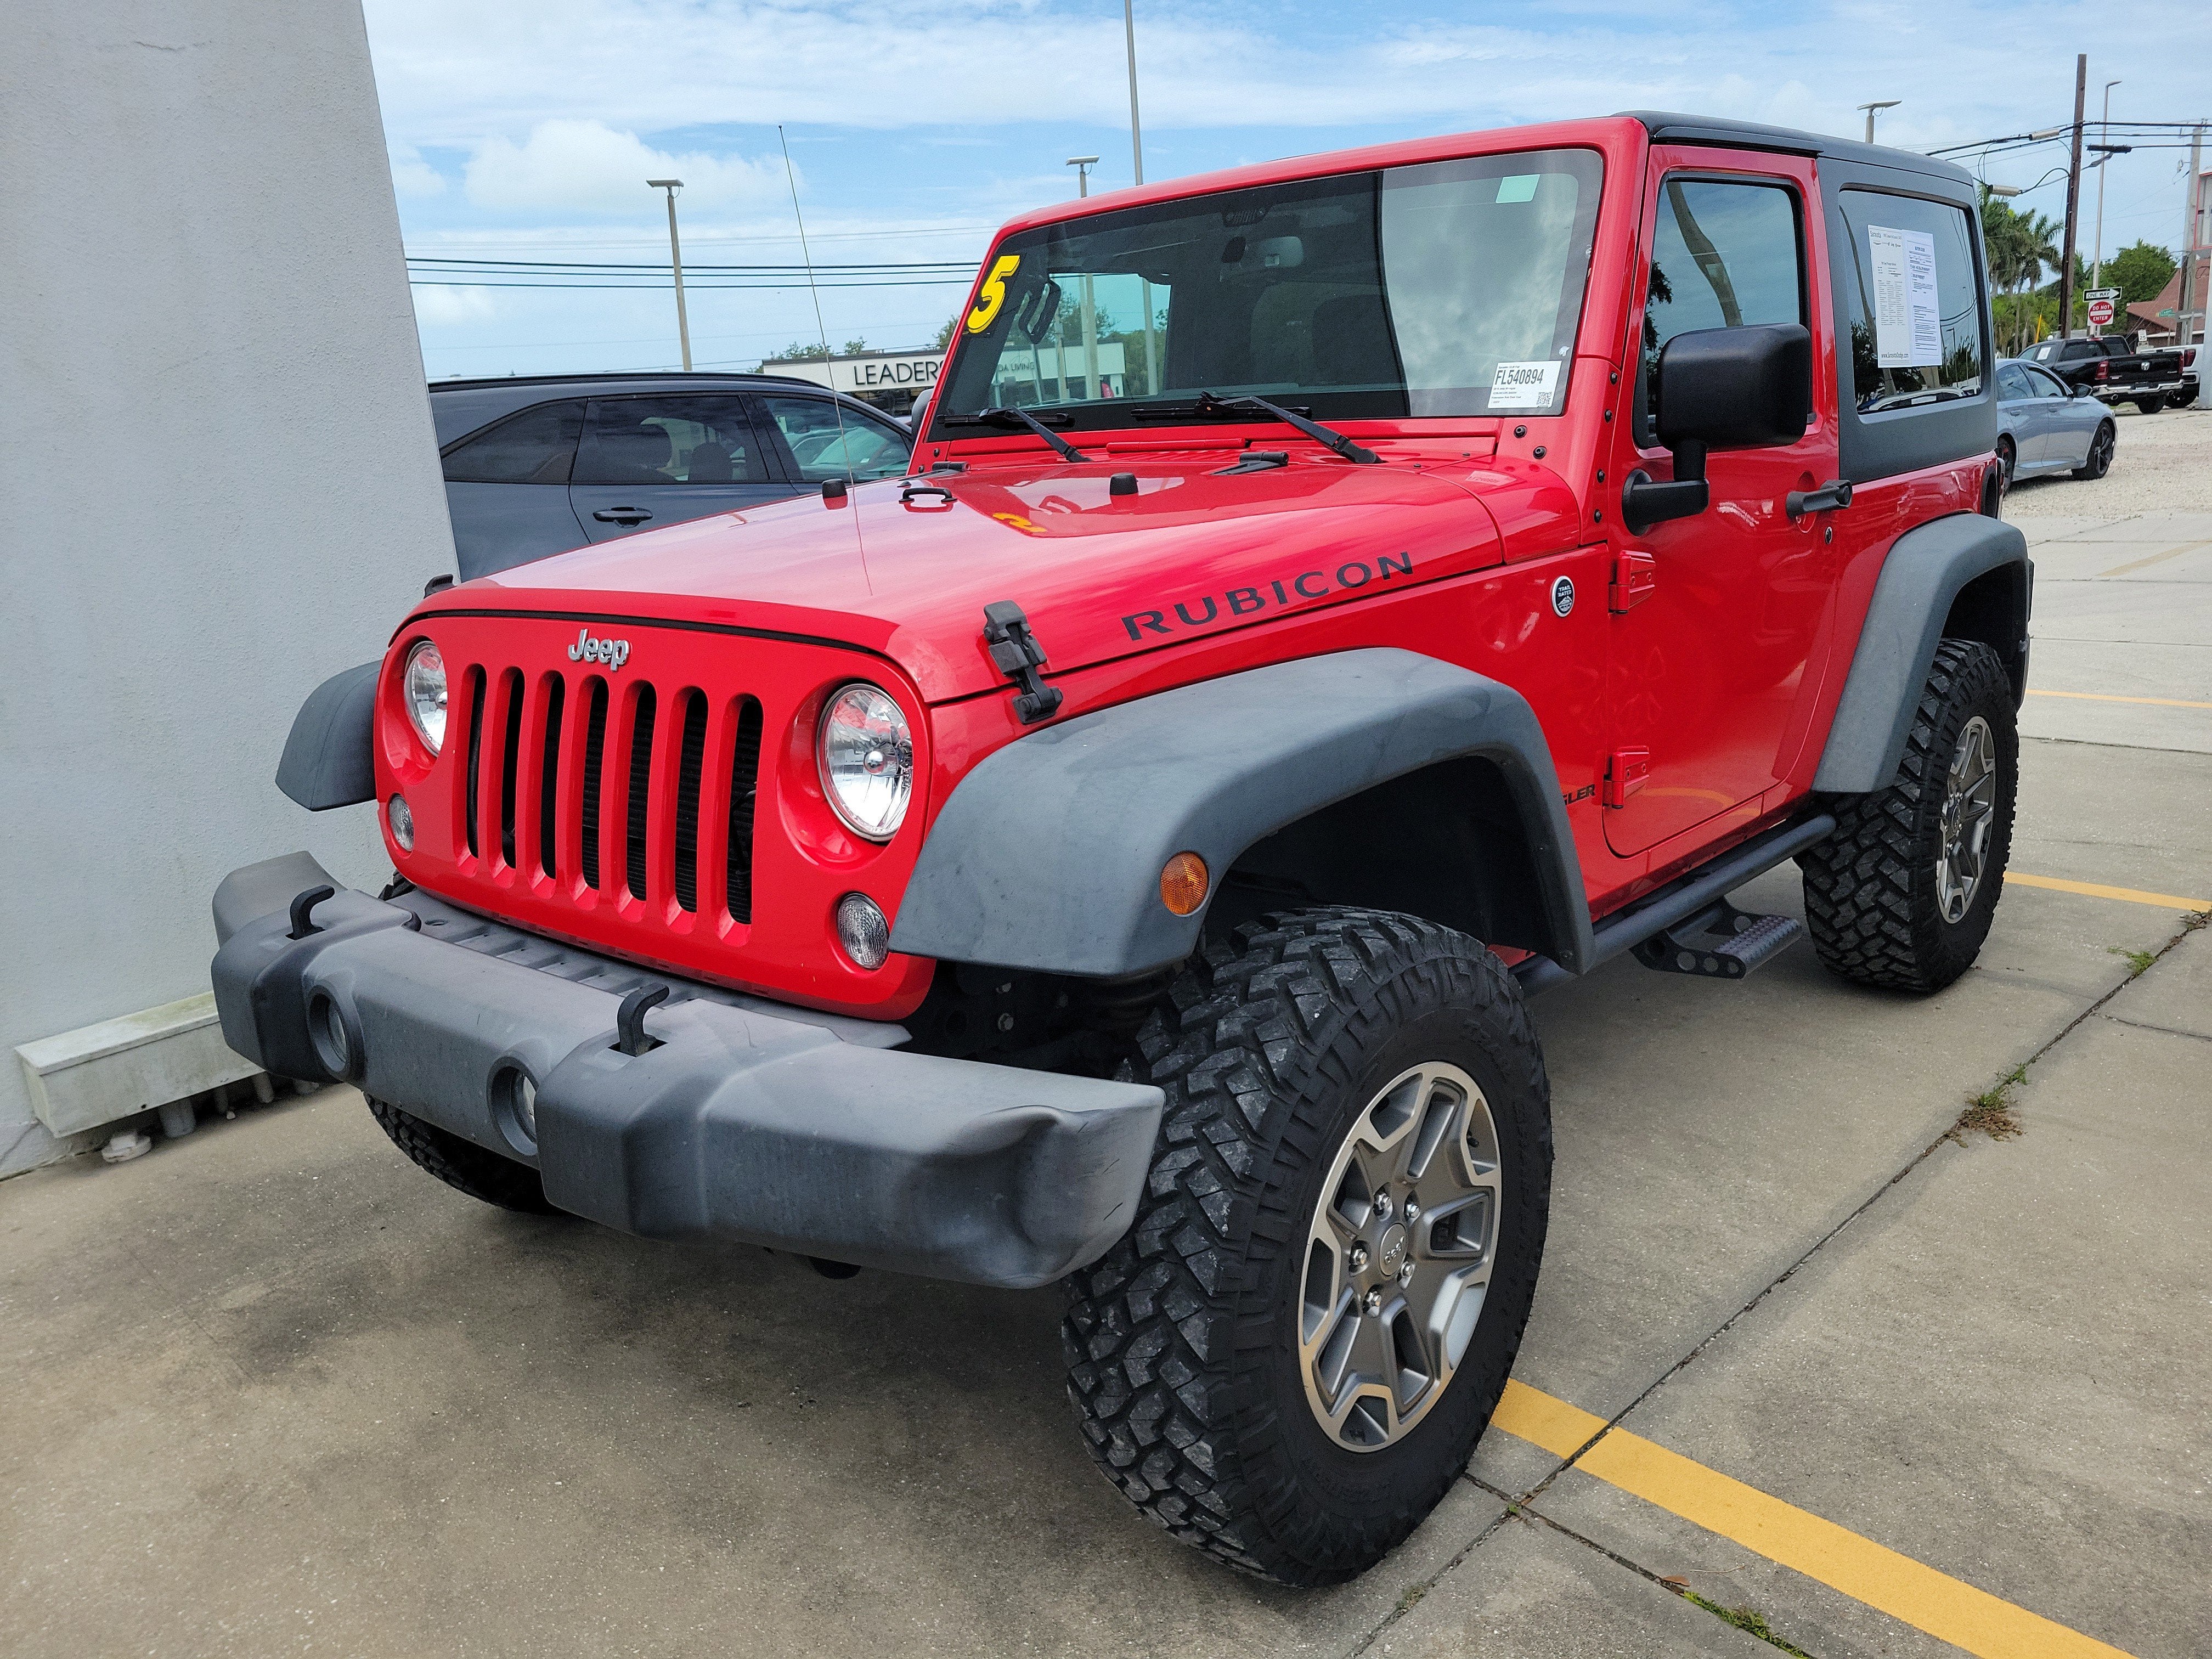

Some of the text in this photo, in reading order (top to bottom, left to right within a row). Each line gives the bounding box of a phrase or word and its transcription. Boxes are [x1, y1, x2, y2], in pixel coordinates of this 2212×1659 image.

[967, 255, 1020, 334] 5
[1495, 369, 1544, 385] FL540894
[1121, 551, 1413, 641] RUBICON
[568, 628, 629, 672] Jeep
